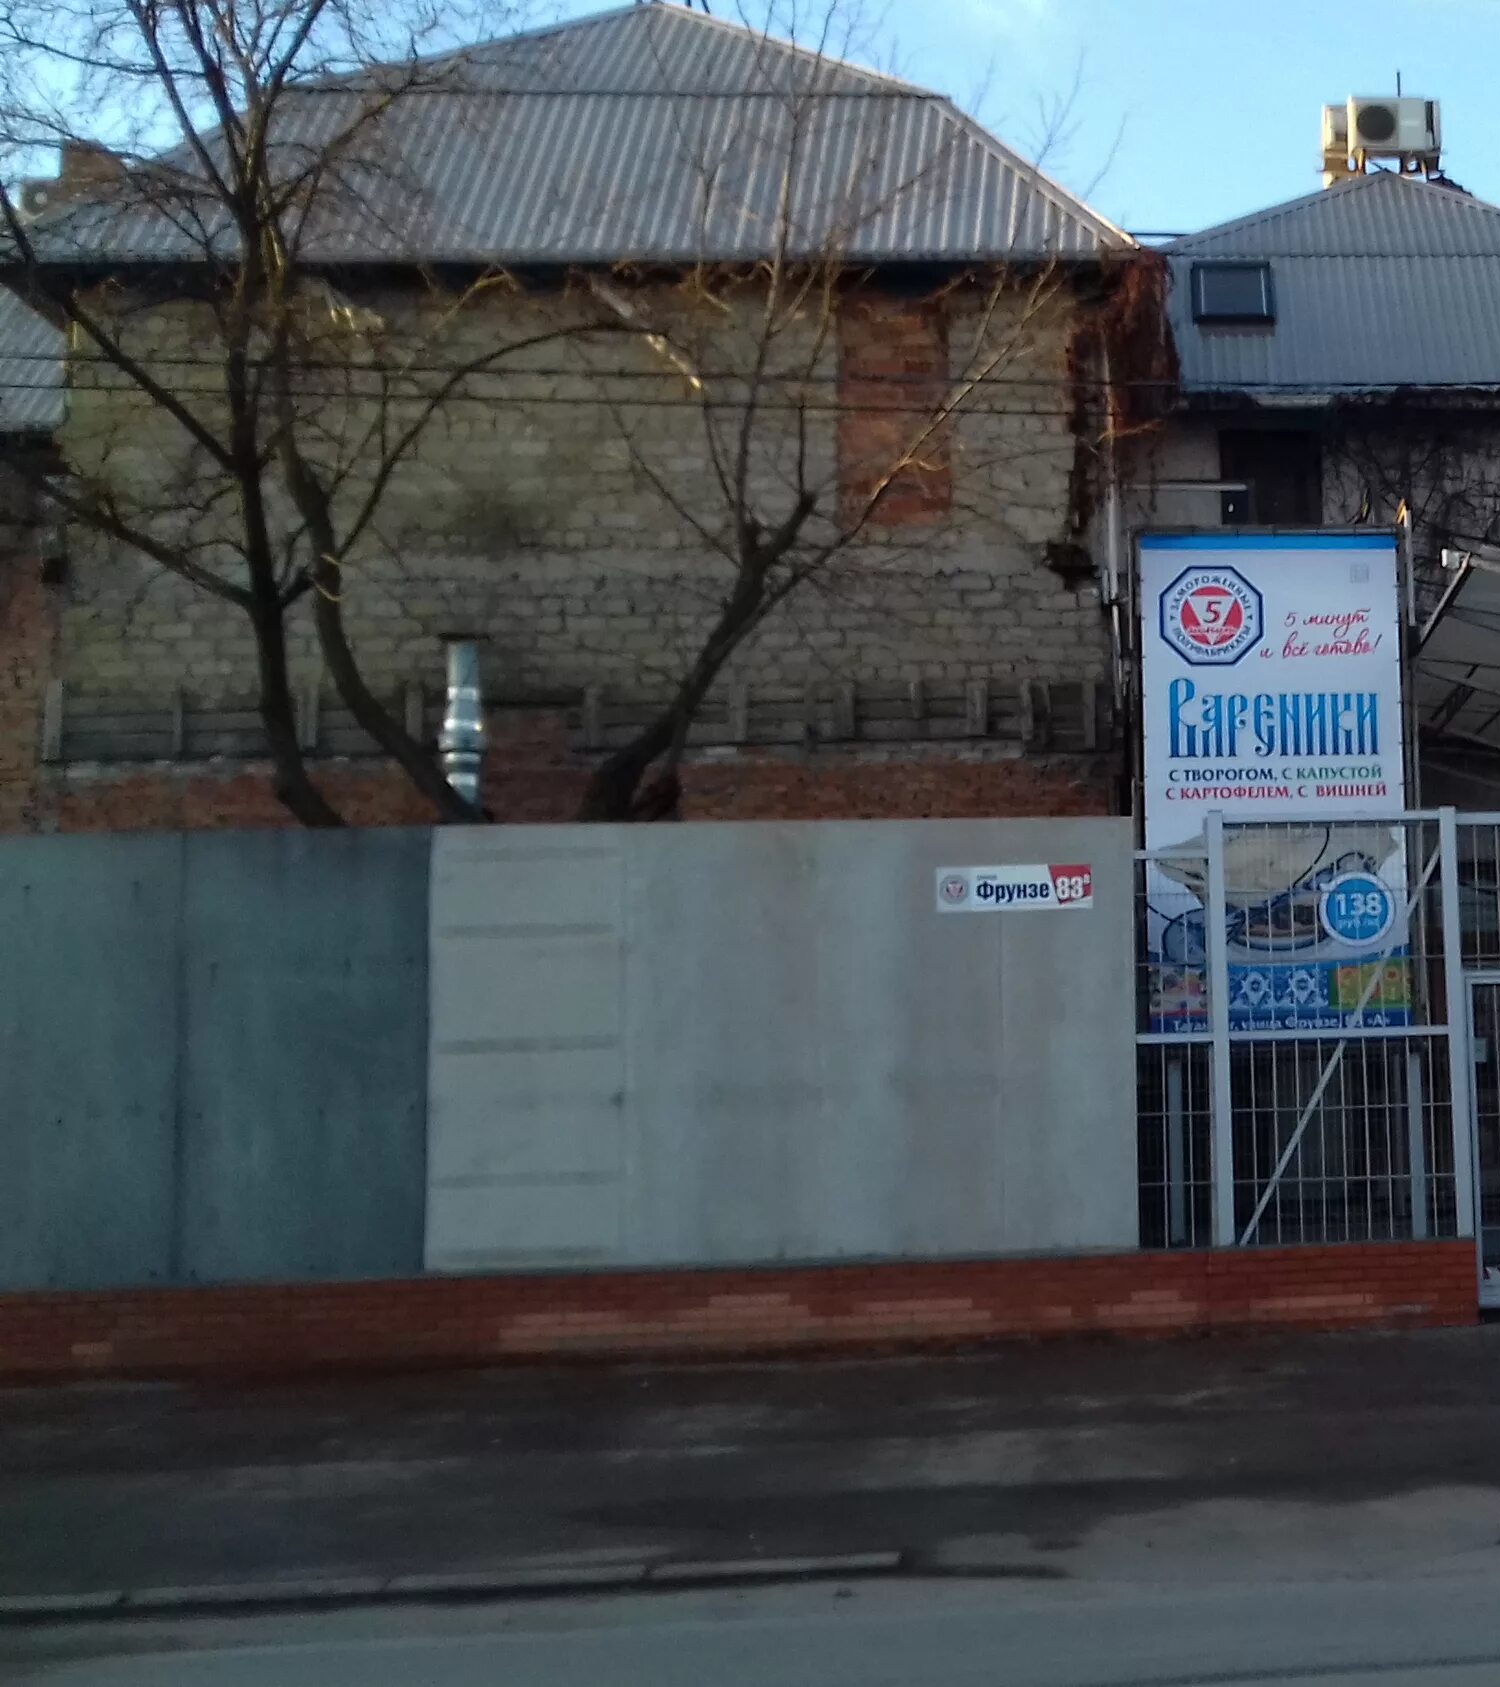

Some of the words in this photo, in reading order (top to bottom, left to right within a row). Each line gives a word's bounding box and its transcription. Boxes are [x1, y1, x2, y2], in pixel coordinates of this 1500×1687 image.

[1203, 600, 1222, 623] 5
[1284, 612, 1297, 627] 5
[1303, 608, 1371, 638] минут
[1260, 648, 1273, 658] и
[1315, 628, 1382, 655] готово!
[1169, 769, 1180, 782] С
[1184, 768, 1277, 783] ТВОРОГОМ,
[1282, 768, 1291, 780] С
[1297, 764, 1382, 780] КАПУСТОЙ
[1166, 787, 1175, 800] С
[1181, 785, 1293, 800] КАРТОФЕЛЕМ,
[1298, 785, 1308, 798] С
[1316, 781, 1387, 797] ВИШНЕЙ
[976, 881, 1050, 903] Фрунзе
[1336, 892, 1382, 917] 138
